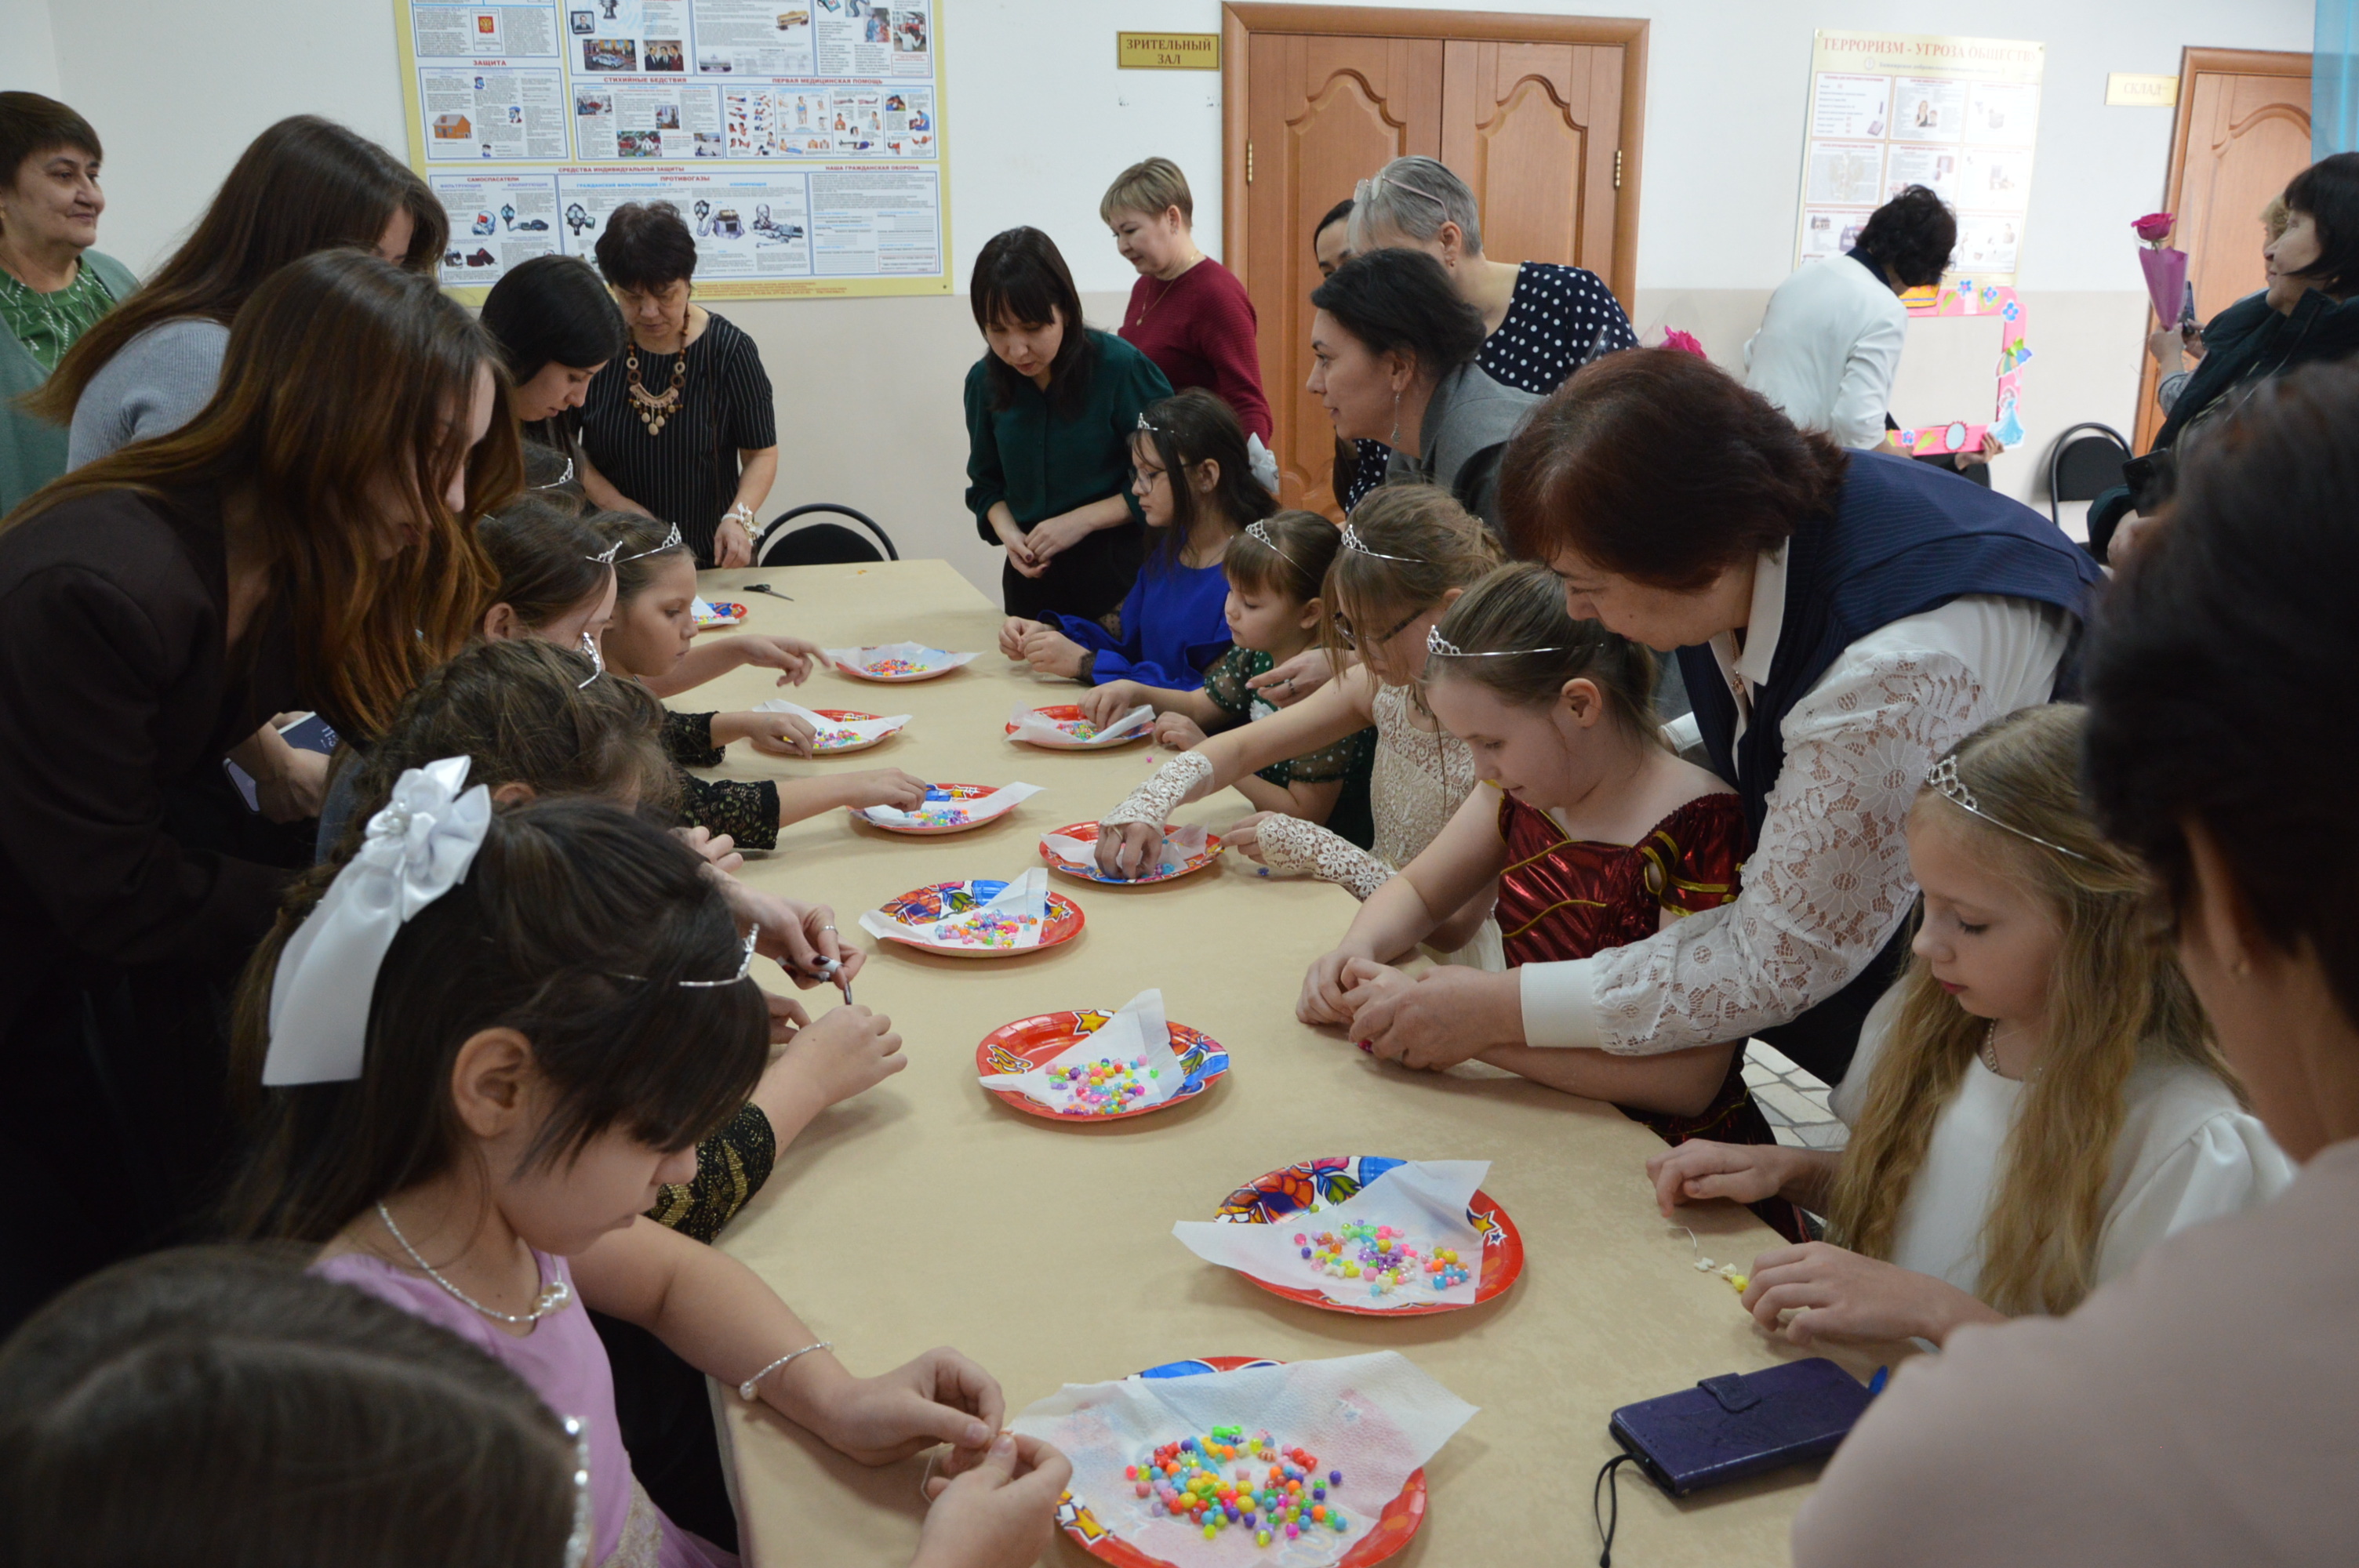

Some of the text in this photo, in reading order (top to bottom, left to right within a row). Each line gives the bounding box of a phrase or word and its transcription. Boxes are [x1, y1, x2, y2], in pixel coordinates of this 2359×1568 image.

[1126, 38, 1212, 51] ЗРИТЕЛЬНЫЙ
[1822, 37, 1904, 55] ТЕРРОРИЗМ
[1915, 42, 1965, 58] УГРОЗА
[1968, 45, 2037, 63] ОБЩЕСТВУ
[1158, 54, 1181, 64] ЗАЛ
[2124, 82, 2161, 96] СКЛАД
